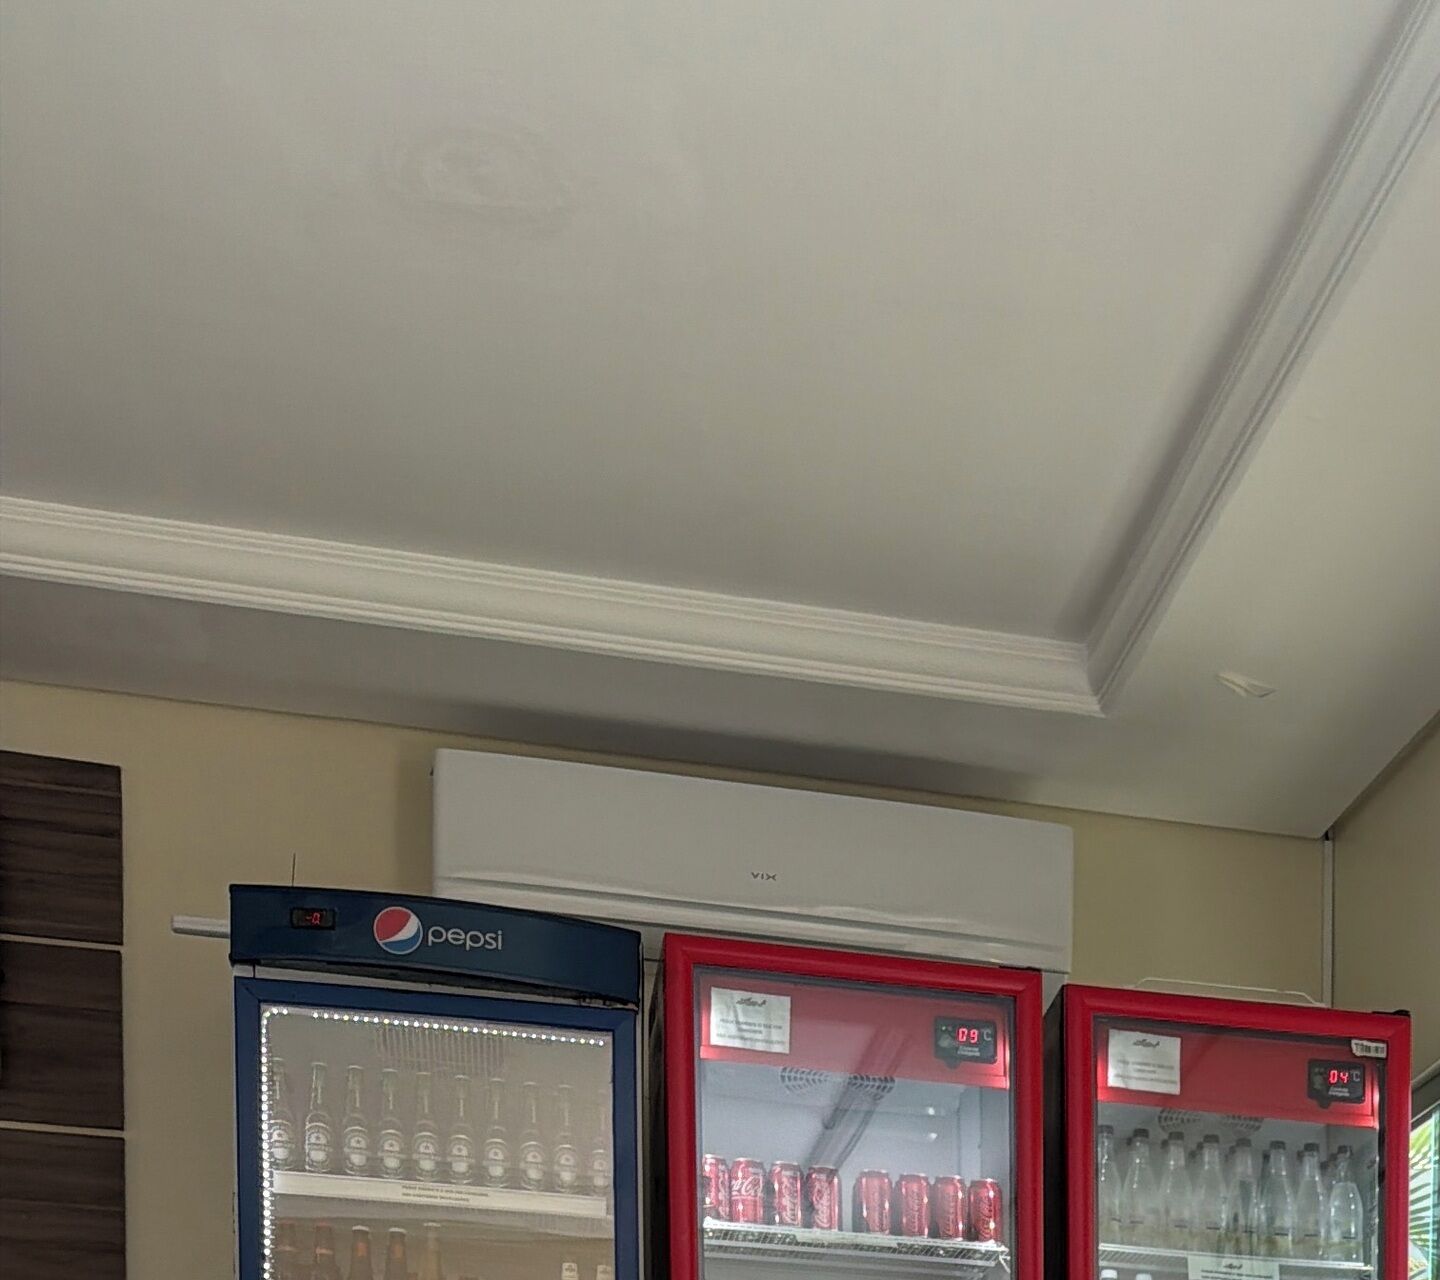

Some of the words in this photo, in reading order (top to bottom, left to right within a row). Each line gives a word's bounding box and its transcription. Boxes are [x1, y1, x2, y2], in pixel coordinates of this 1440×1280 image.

[750, 871, 777, 881] VIX
[427, 925, 504, 951] pepsi
[1329, 1069, 1350, 1084] 04
